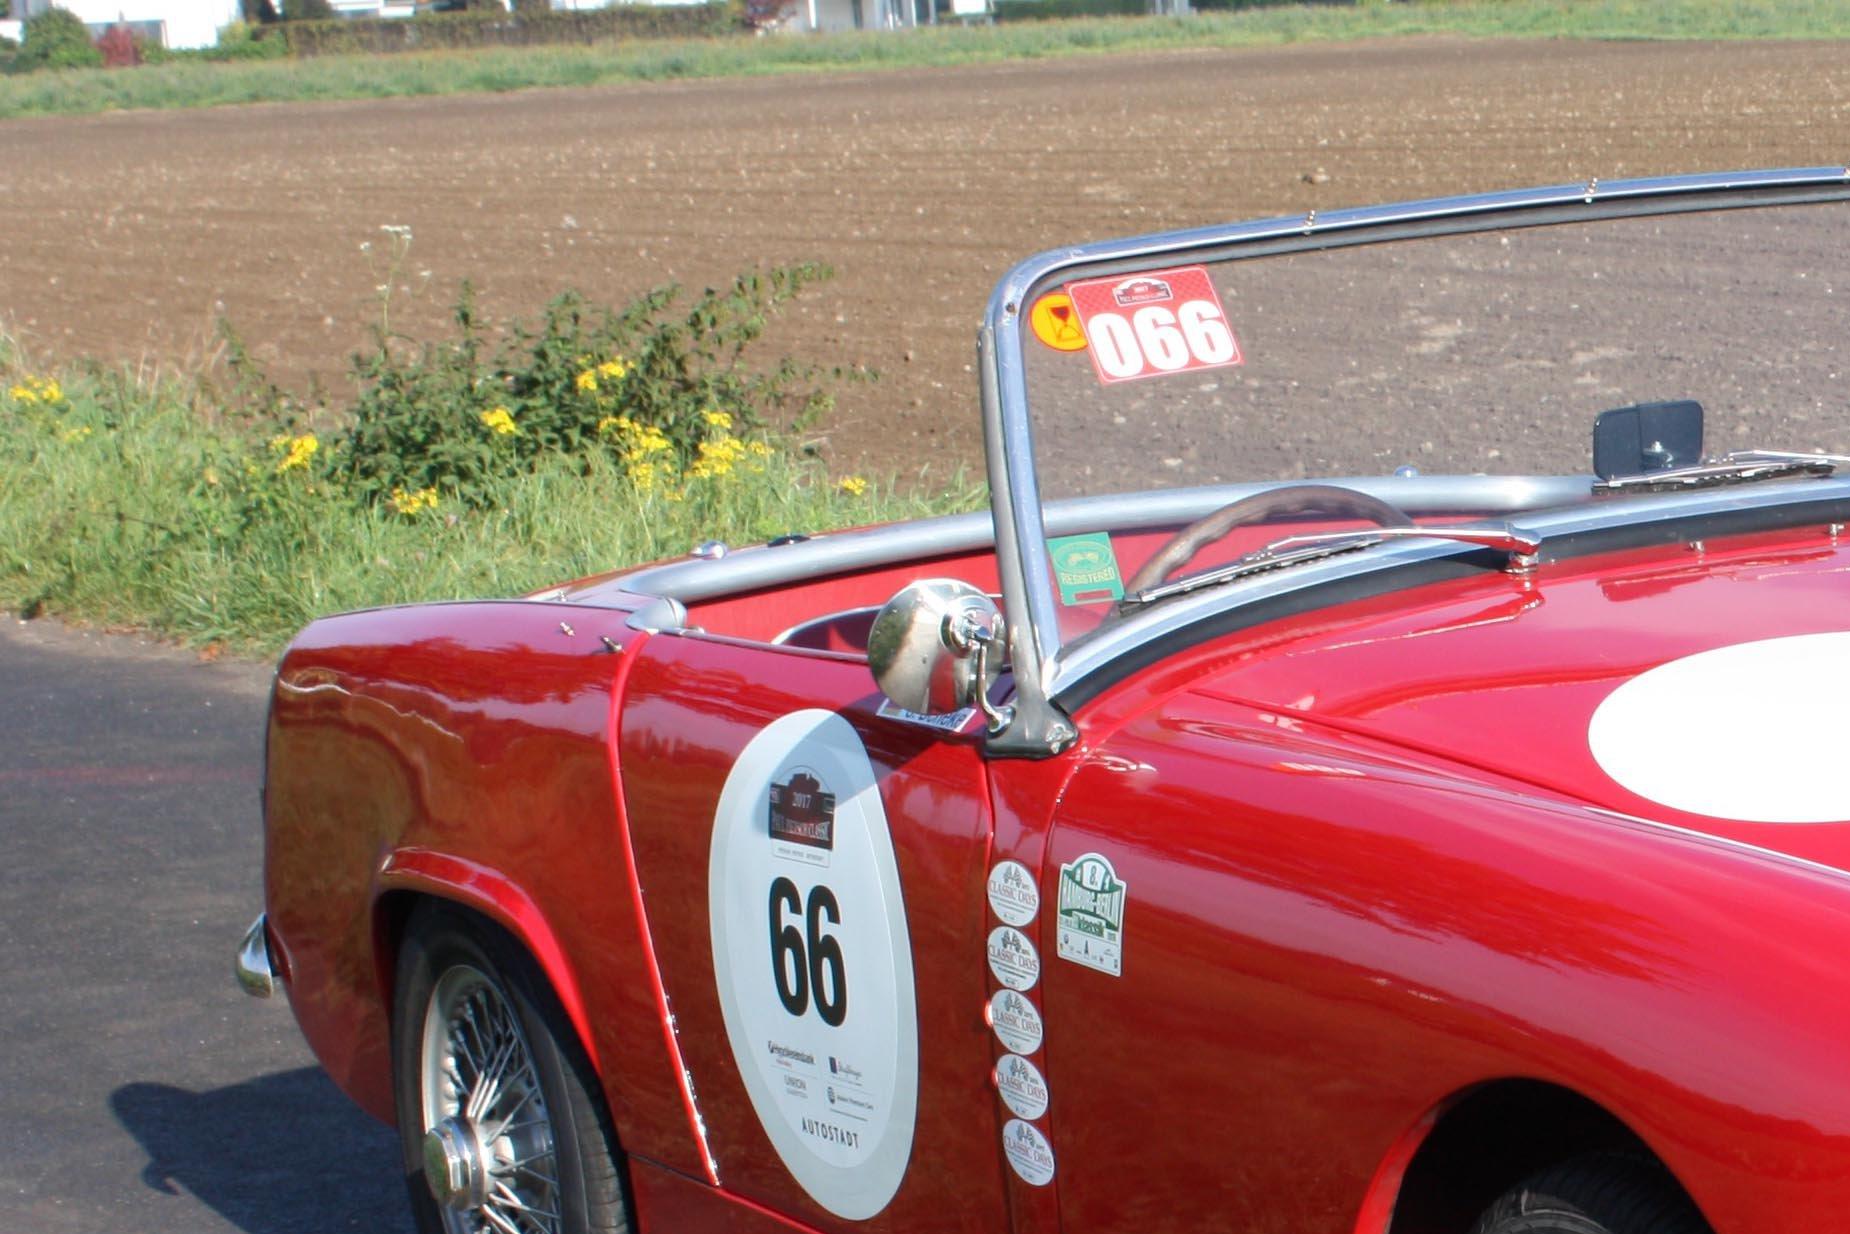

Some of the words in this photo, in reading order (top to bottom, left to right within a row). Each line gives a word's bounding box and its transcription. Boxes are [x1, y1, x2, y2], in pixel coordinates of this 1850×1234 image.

[1088, 299, 1234, 378] 066
[791, 791, 812, 809] 2017
[989, 880, 1016, 900] CLASSIC
[1018, 889, 1037, 906] DAYS
[769, 876, 847, 1028] 66
[988, 944, 1016, 965] CLASSIC
[1018, 956, 1038, 973] DAYS
[992, 1009, 1020, 1028] CLASSIC
[1021, 1018, 1040, 1036] DAYS
[998, 1072, 1025, 1092] CLASSIC
[1026, 1083, 1047, 1101] DAYS
[801, 1117, 859, 1149] AUTOSTADT
[1003, 1135, 1032, 1158] CLASSIC
[1033, 1151, 1053, 1169] DAYS
